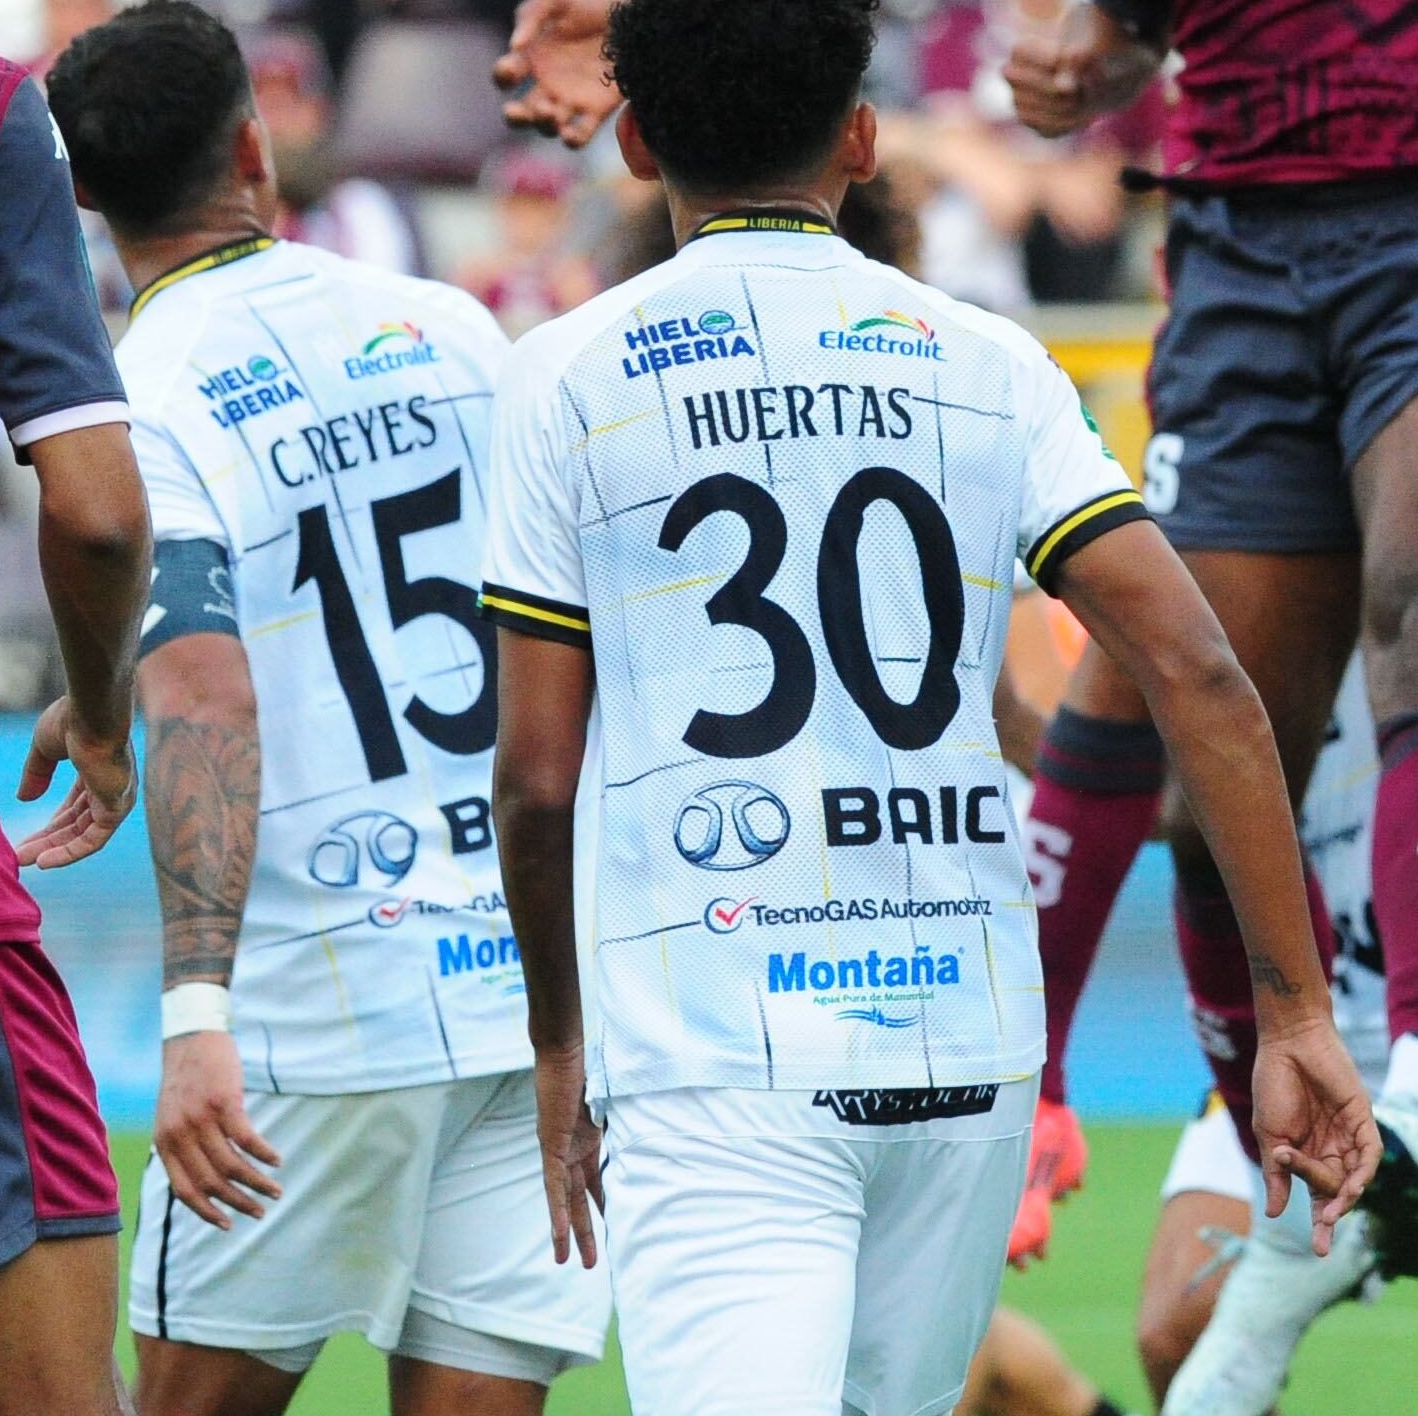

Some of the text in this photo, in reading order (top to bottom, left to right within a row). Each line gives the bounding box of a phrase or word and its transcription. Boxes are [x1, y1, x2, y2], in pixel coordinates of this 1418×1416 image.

[749, 218, 801, 231] LIBERIA
[343, 341, 442, 381] Electrolit
[623, 336, 756, 380] LIBERIA
[819, 331, 947, 361] Electrolit
[271, 395, 438, 488] C.REYES
[683, 383, 913, 450] HUERTAS
[292, 466, 499, 783] 15
[657, 466, 965, 759] 30
[821, 784, 1006, 847] BAIC
[768, 945, 960, 993] Montaña
